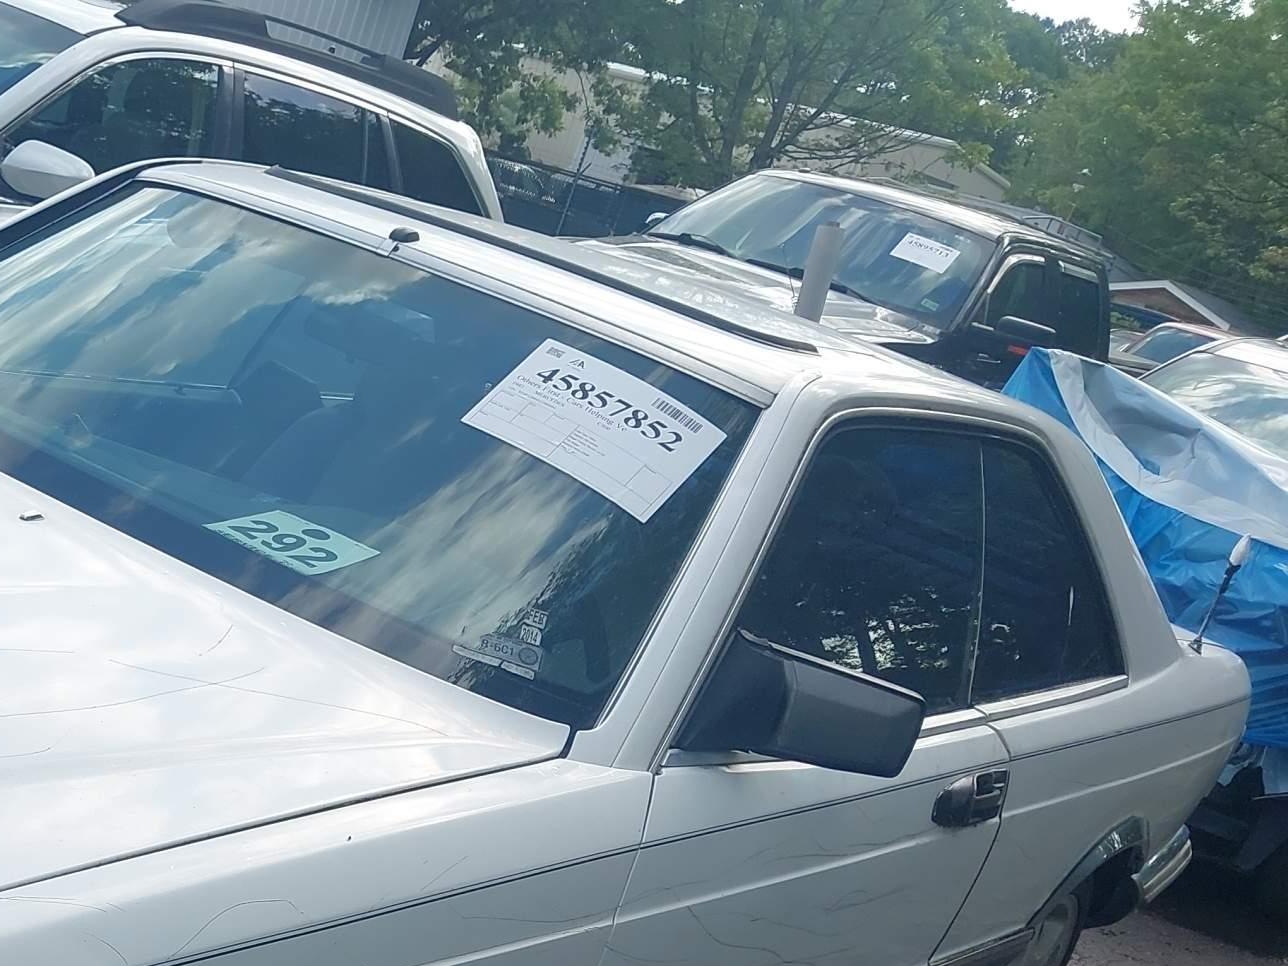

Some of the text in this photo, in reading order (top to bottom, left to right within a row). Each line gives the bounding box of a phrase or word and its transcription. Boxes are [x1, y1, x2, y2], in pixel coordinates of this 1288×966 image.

[535, 367, 685, 454] 45857852
[566, 397, 583, 409] Cars
[584, 405, 615, 426] Helping
[227, 519, 339, 569] 292
